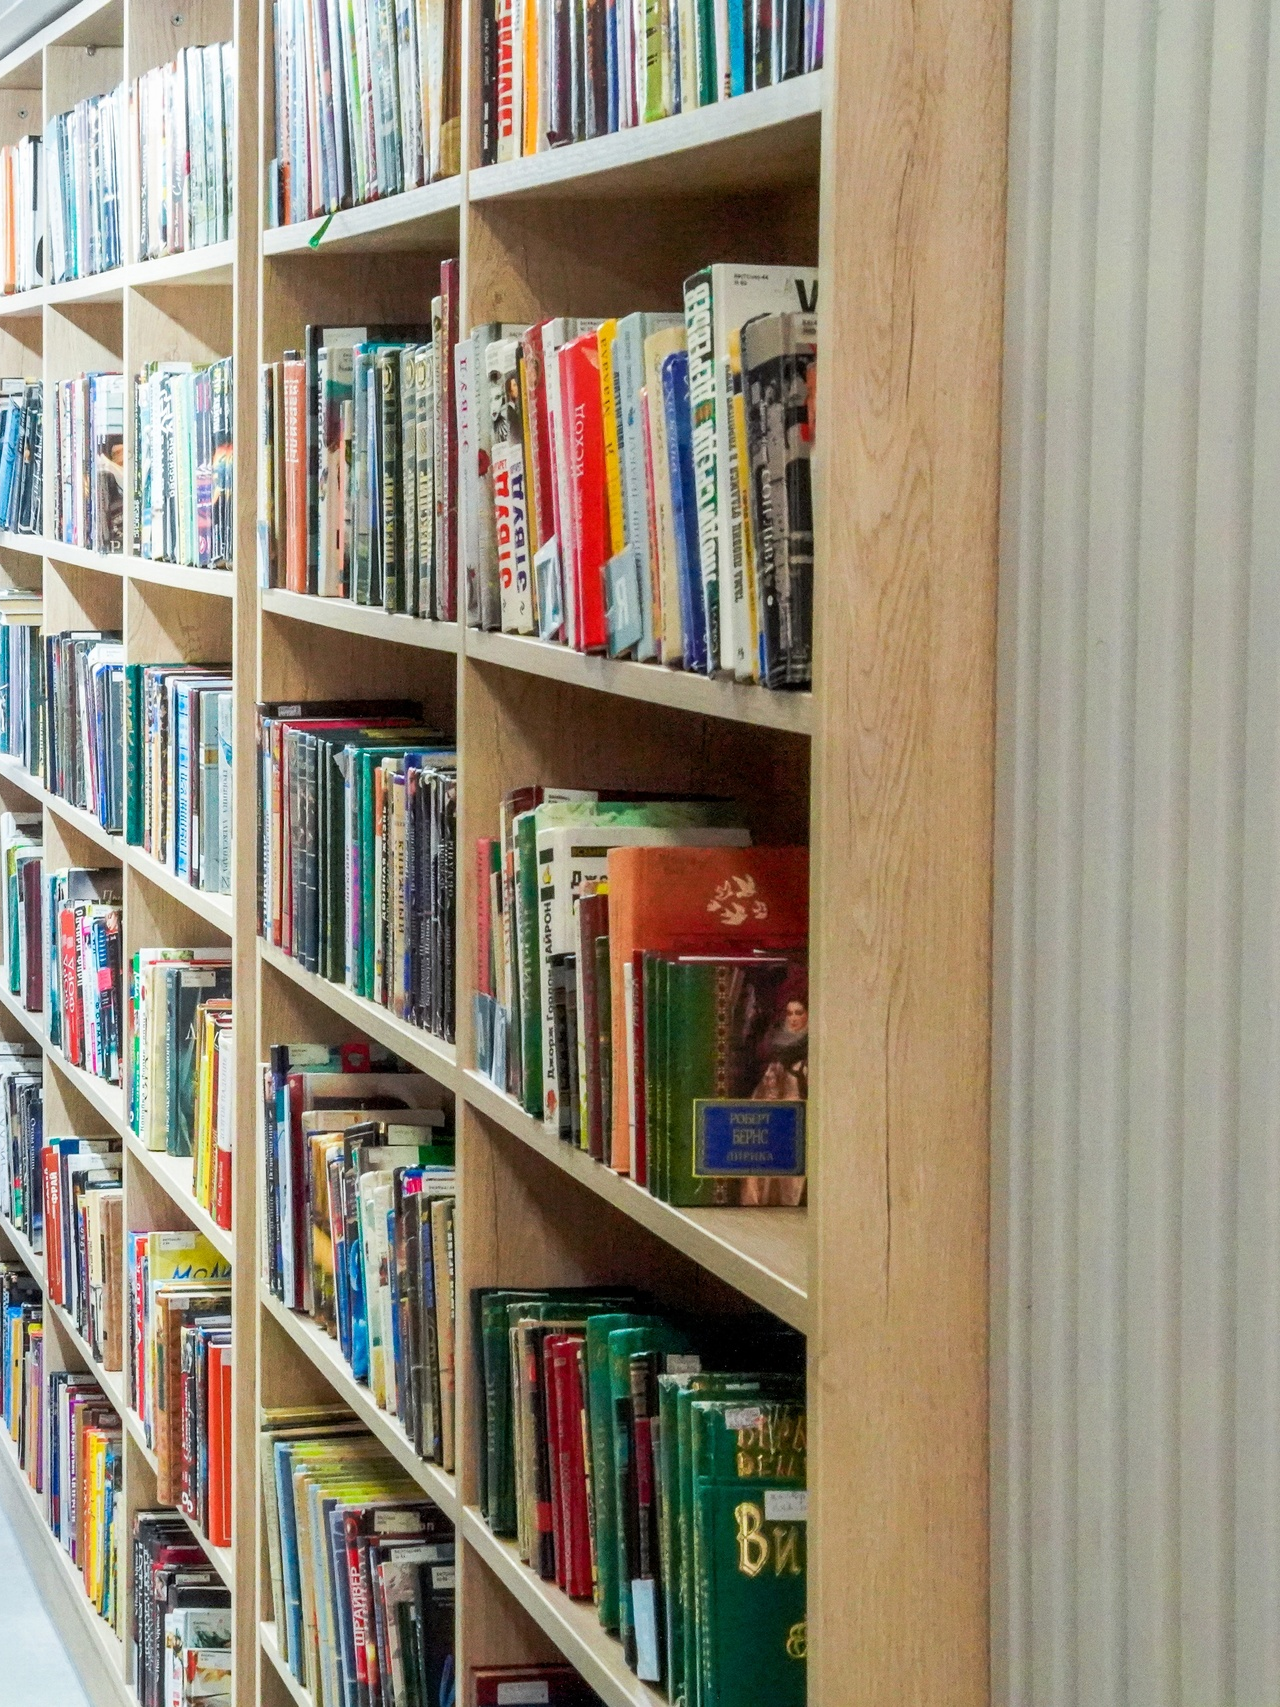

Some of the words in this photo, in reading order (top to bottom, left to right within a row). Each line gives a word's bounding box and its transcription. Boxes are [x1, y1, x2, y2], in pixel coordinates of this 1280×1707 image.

[684, 281, 717, 403] ДЕРЕВЬЕВ
[694, 418, 718, 502] СРЕДИ
[494, 471, 512, 589] ЭТВУД
[510, 473, 527, 593] ЭТВУД
[696, 505, 719, 582] ЛЮДИ
[730, 1113, 771, 1124] РОБЕРТ
[732, 1128, 769, 1145] БЕРНС
[50, 1172, 58, 1204] ФРАЙ
[351, 1566, 365, 1647] ШРАЙВЕР
